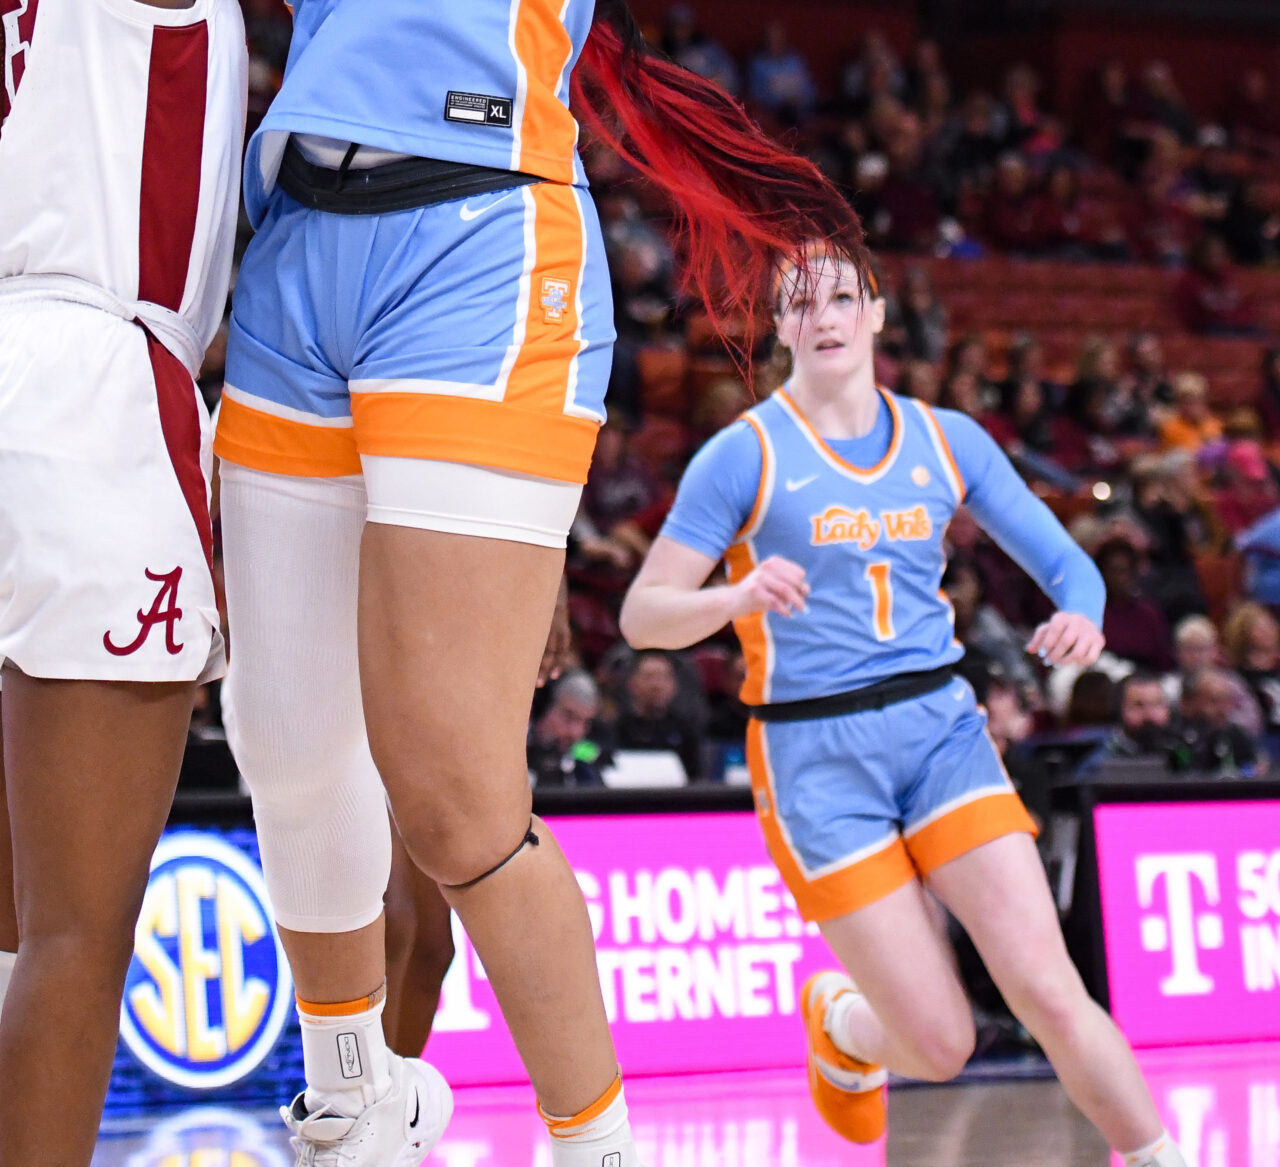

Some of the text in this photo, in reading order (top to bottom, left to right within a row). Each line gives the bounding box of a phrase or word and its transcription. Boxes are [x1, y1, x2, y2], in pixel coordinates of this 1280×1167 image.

[451, 95, 486, 103] ENGINEERED
[490, 105, 507, 119] XL
[810, 503, 932, 550] Lady Vols
[103, 565, 184, 656] A
[865, 561, 896, 642] 1
[607, 865, 783, 945] HOME
[129, 868, 270, 1062] SEC
[596, 941, 803, 1025] TERNET
